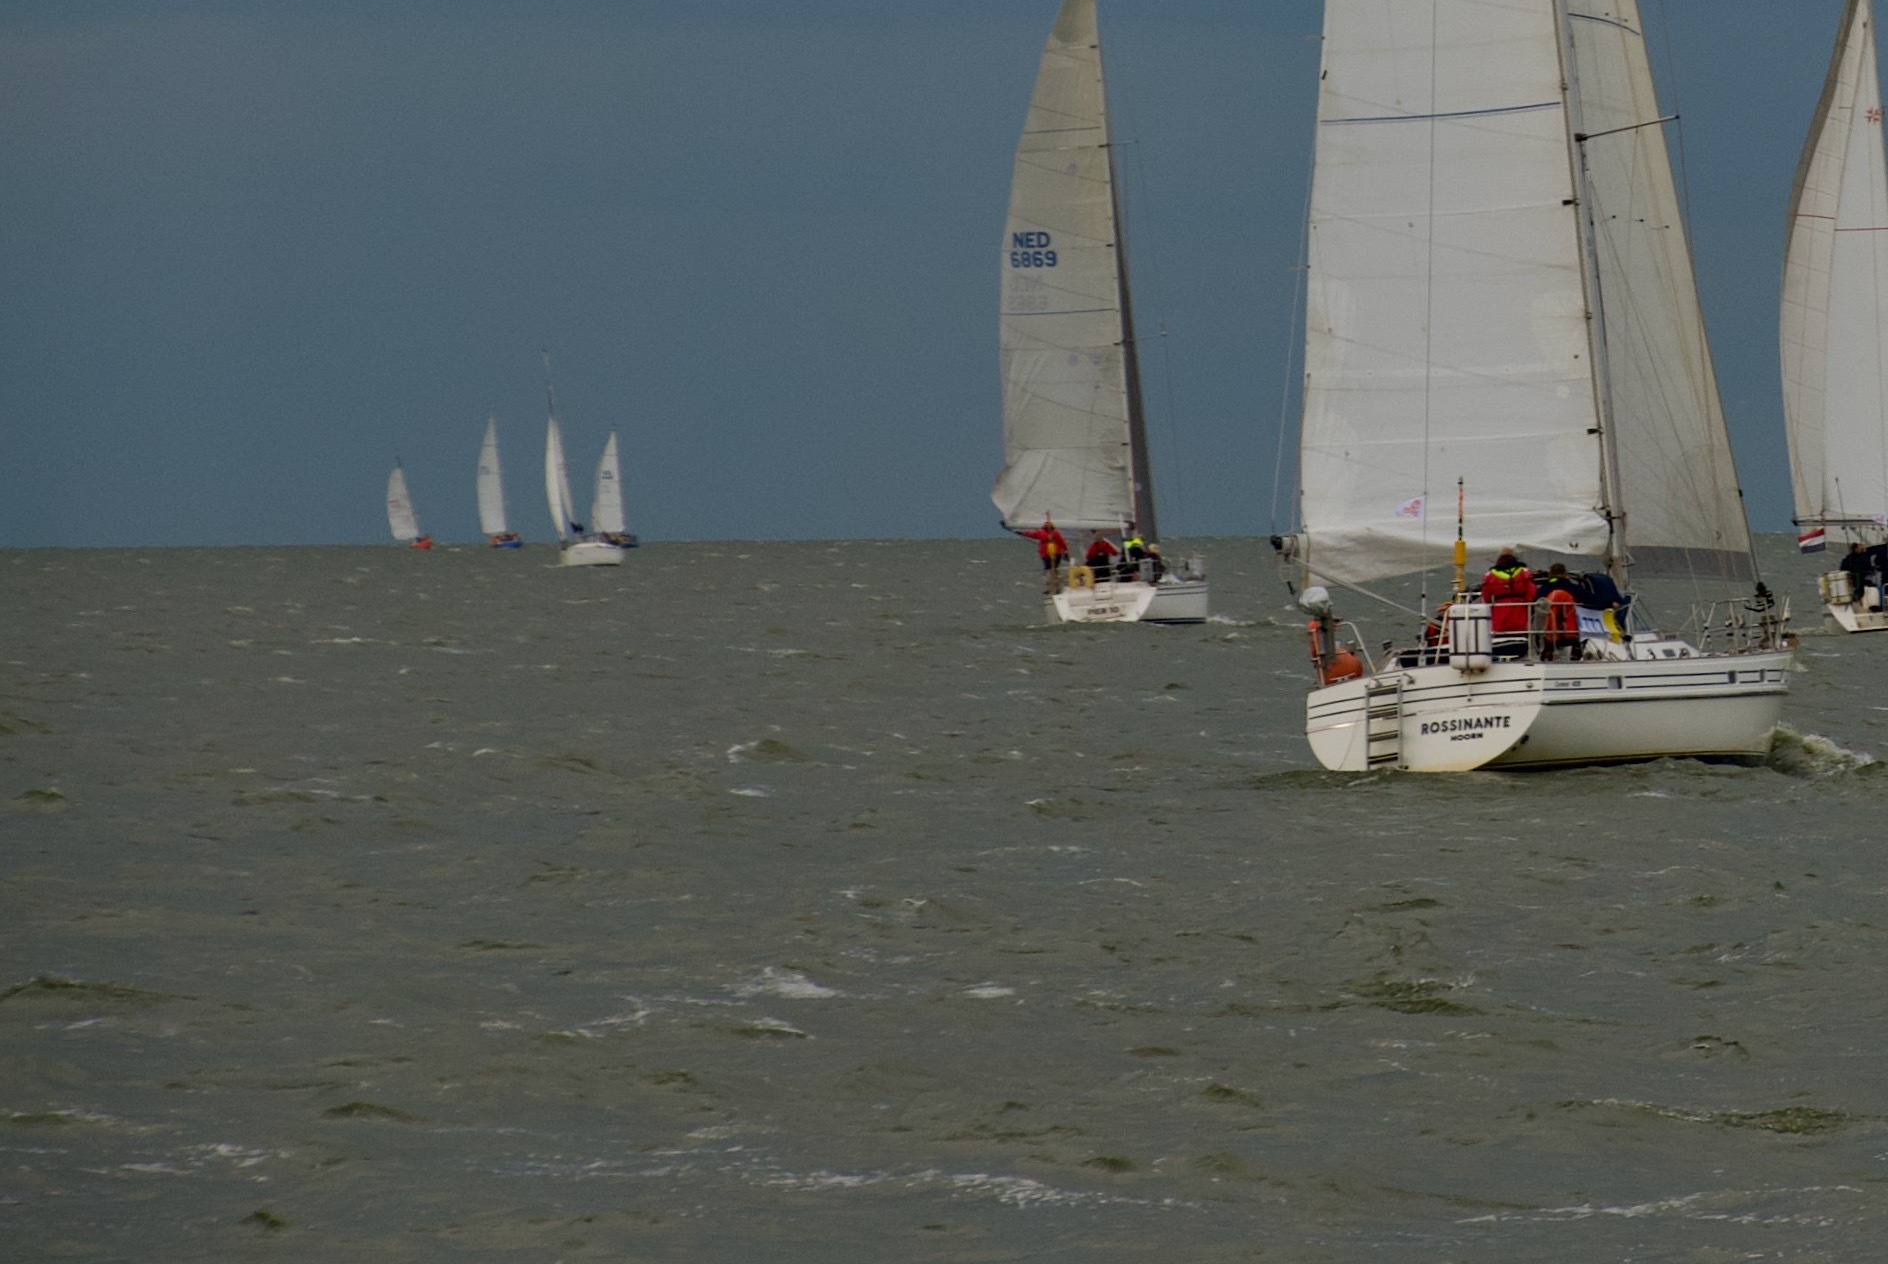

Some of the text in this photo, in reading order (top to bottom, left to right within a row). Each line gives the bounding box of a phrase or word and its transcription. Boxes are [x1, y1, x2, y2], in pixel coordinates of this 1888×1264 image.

[1011, 231, 1050, 249] NED
[1010, 250, 1057, 268] 6869
[1421, 716, 1511, 735] ROSSINANTE
[1450, 732, 1484, 741] HOORN
